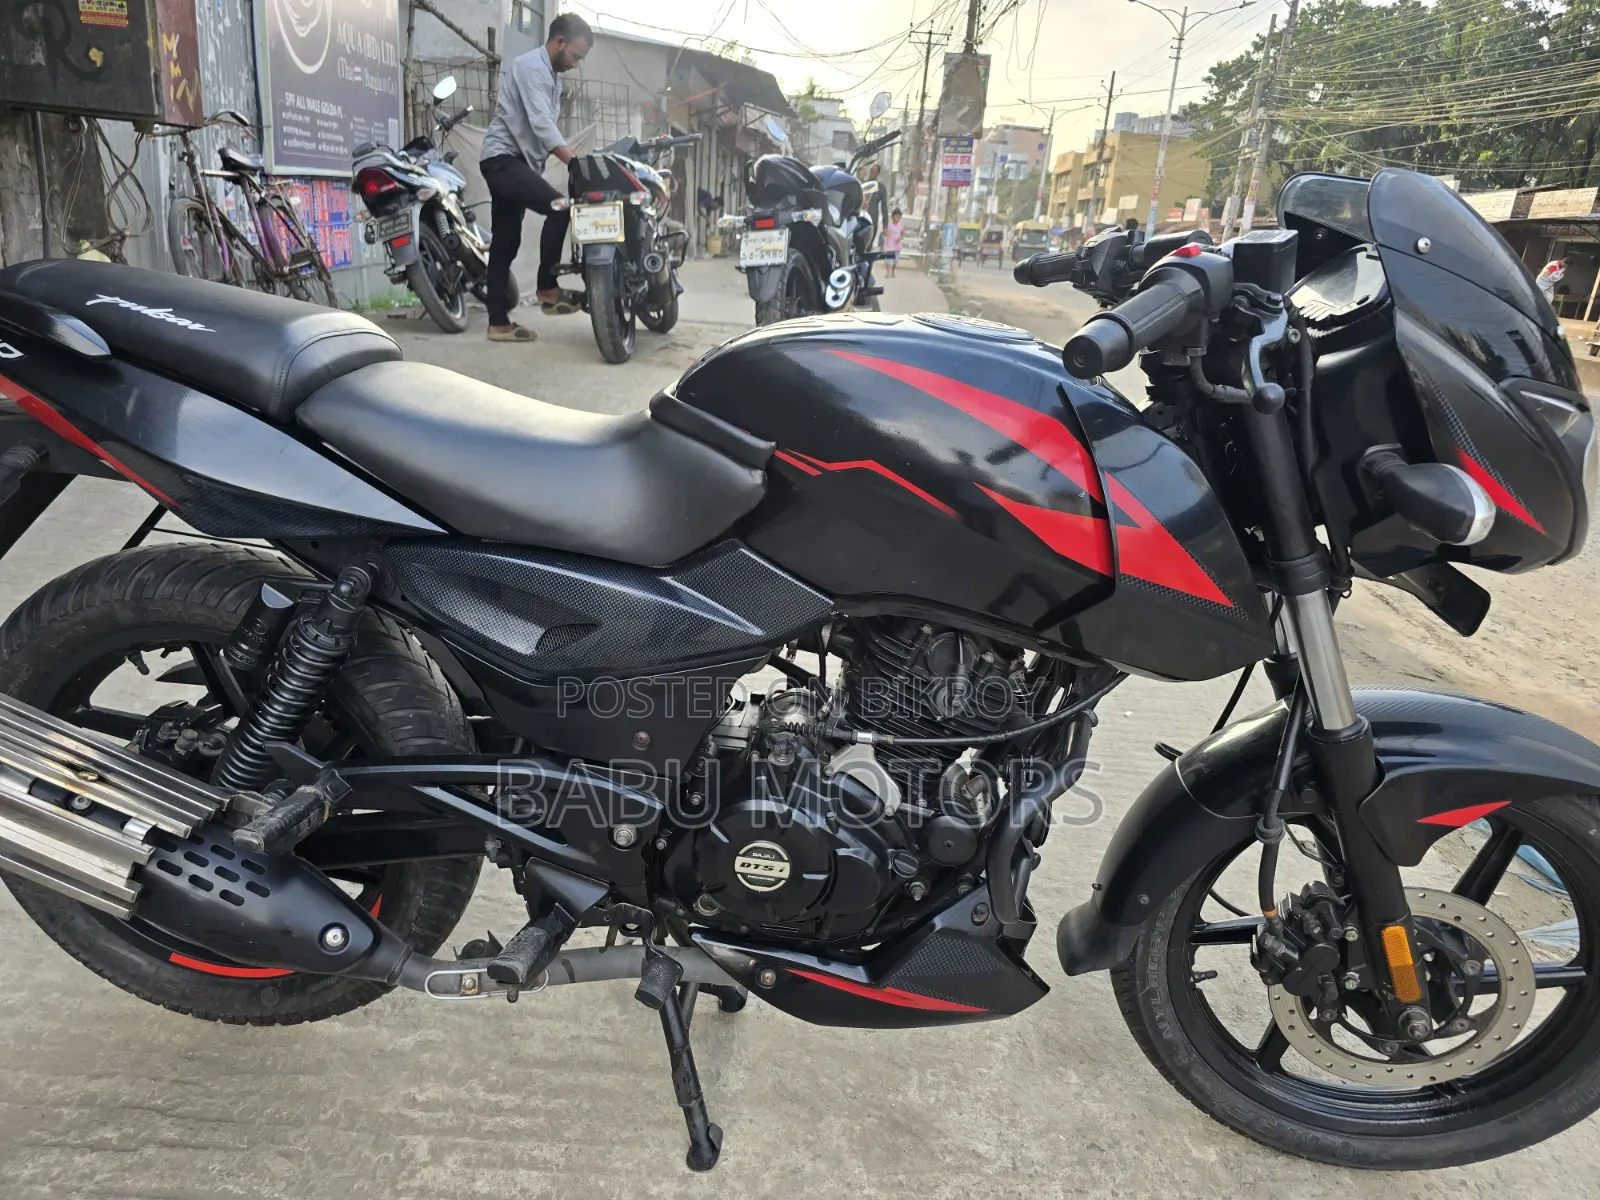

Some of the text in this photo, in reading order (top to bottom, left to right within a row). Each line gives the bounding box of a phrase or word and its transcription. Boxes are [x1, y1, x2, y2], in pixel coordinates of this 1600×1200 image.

[337, 20, 363, 54] AQUA
[296, 94, 306, 110] ALL
[306, 97, 321, 113] MALE
